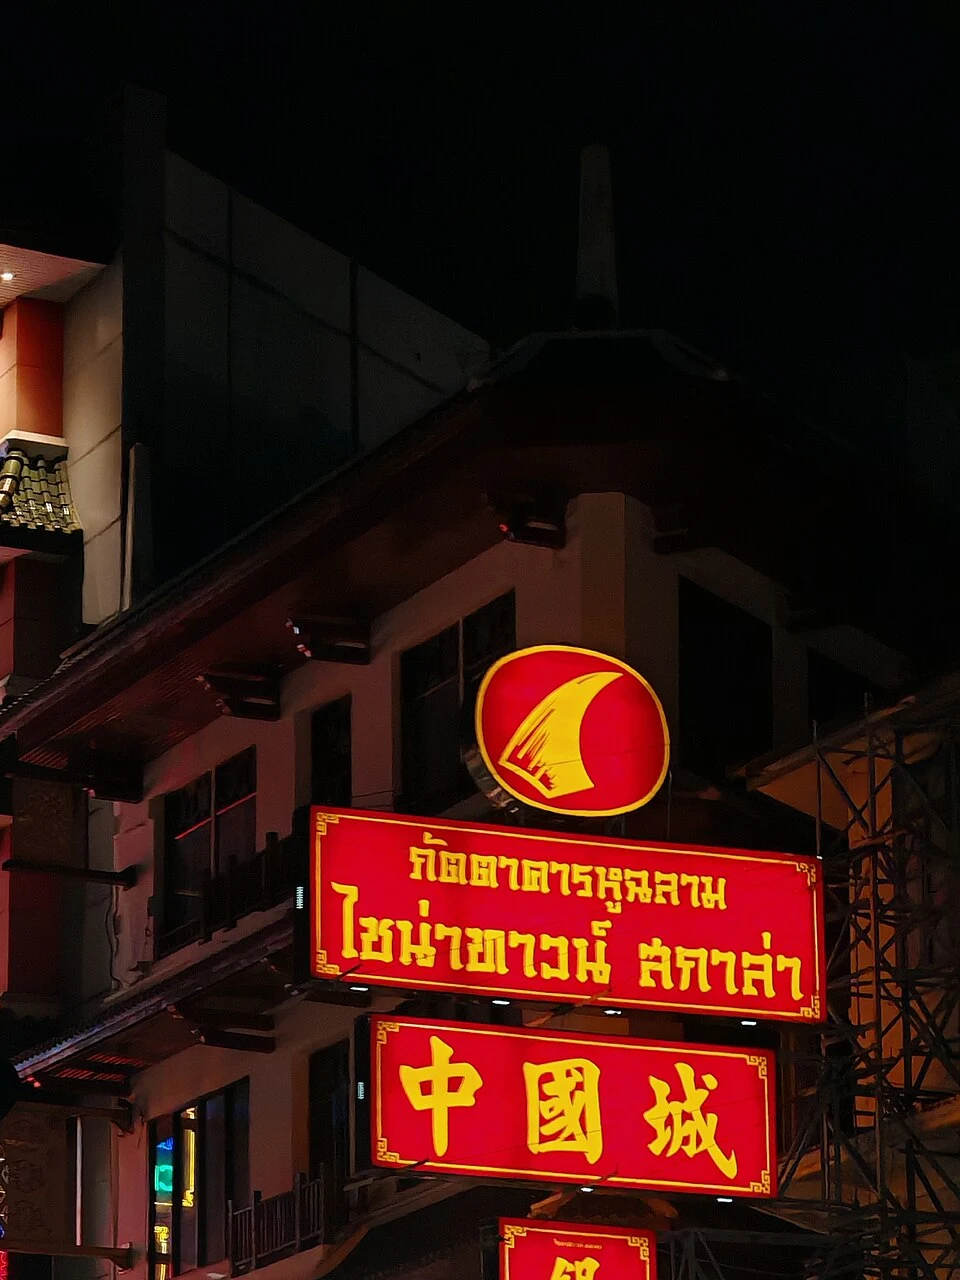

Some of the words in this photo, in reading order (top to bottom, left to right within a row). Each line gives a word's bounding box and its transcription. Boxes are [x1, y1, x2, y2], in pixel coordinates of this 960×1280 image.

[331, 882, 612, 984] ไชน่าทาวน์
[638, 931, 804, 1000] สกาล่า
[398, 1036, 737, 1180] 中國城
